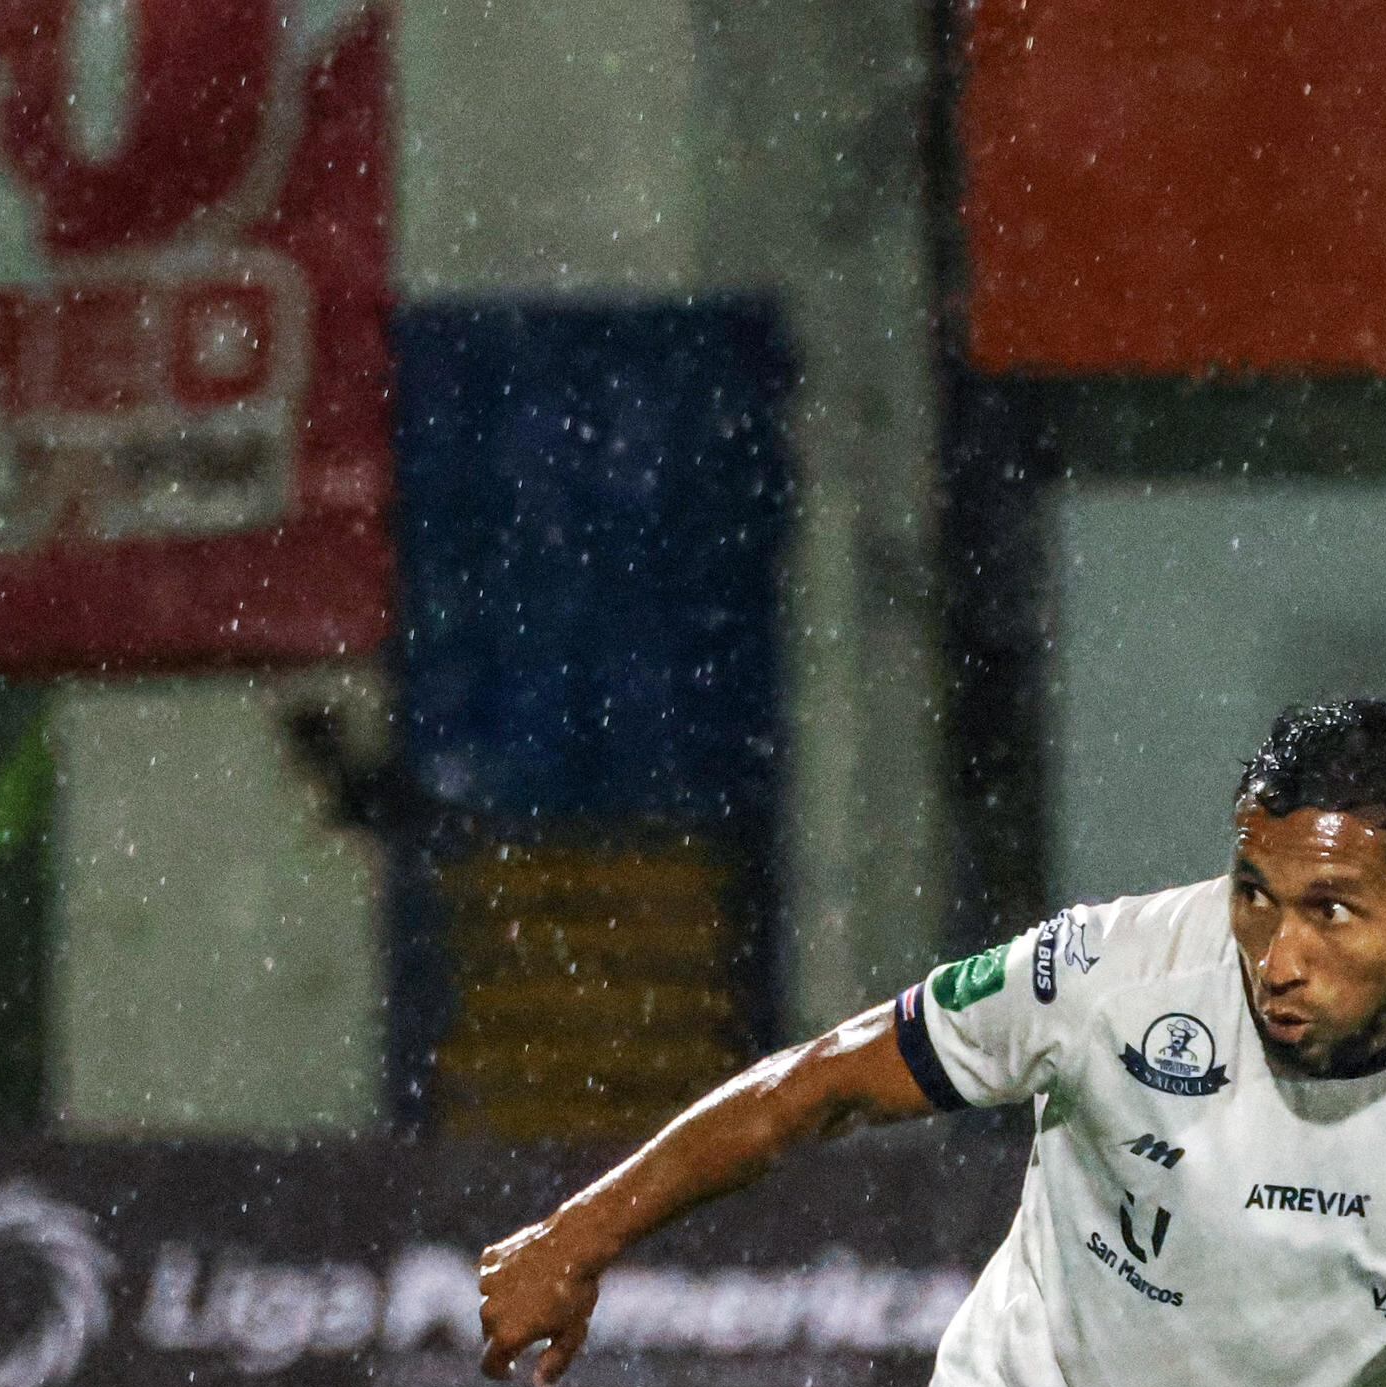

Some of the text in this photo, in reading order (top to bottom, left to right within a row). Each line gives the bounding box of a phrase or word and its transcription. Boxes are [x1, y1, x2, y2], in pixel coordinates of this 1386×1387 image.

[1036, 947, 1052, 991] BUS
[1244, 1183, 1367, 1218] ATREVIA
[1085, 1231, 1185, 1308] San Marcos
